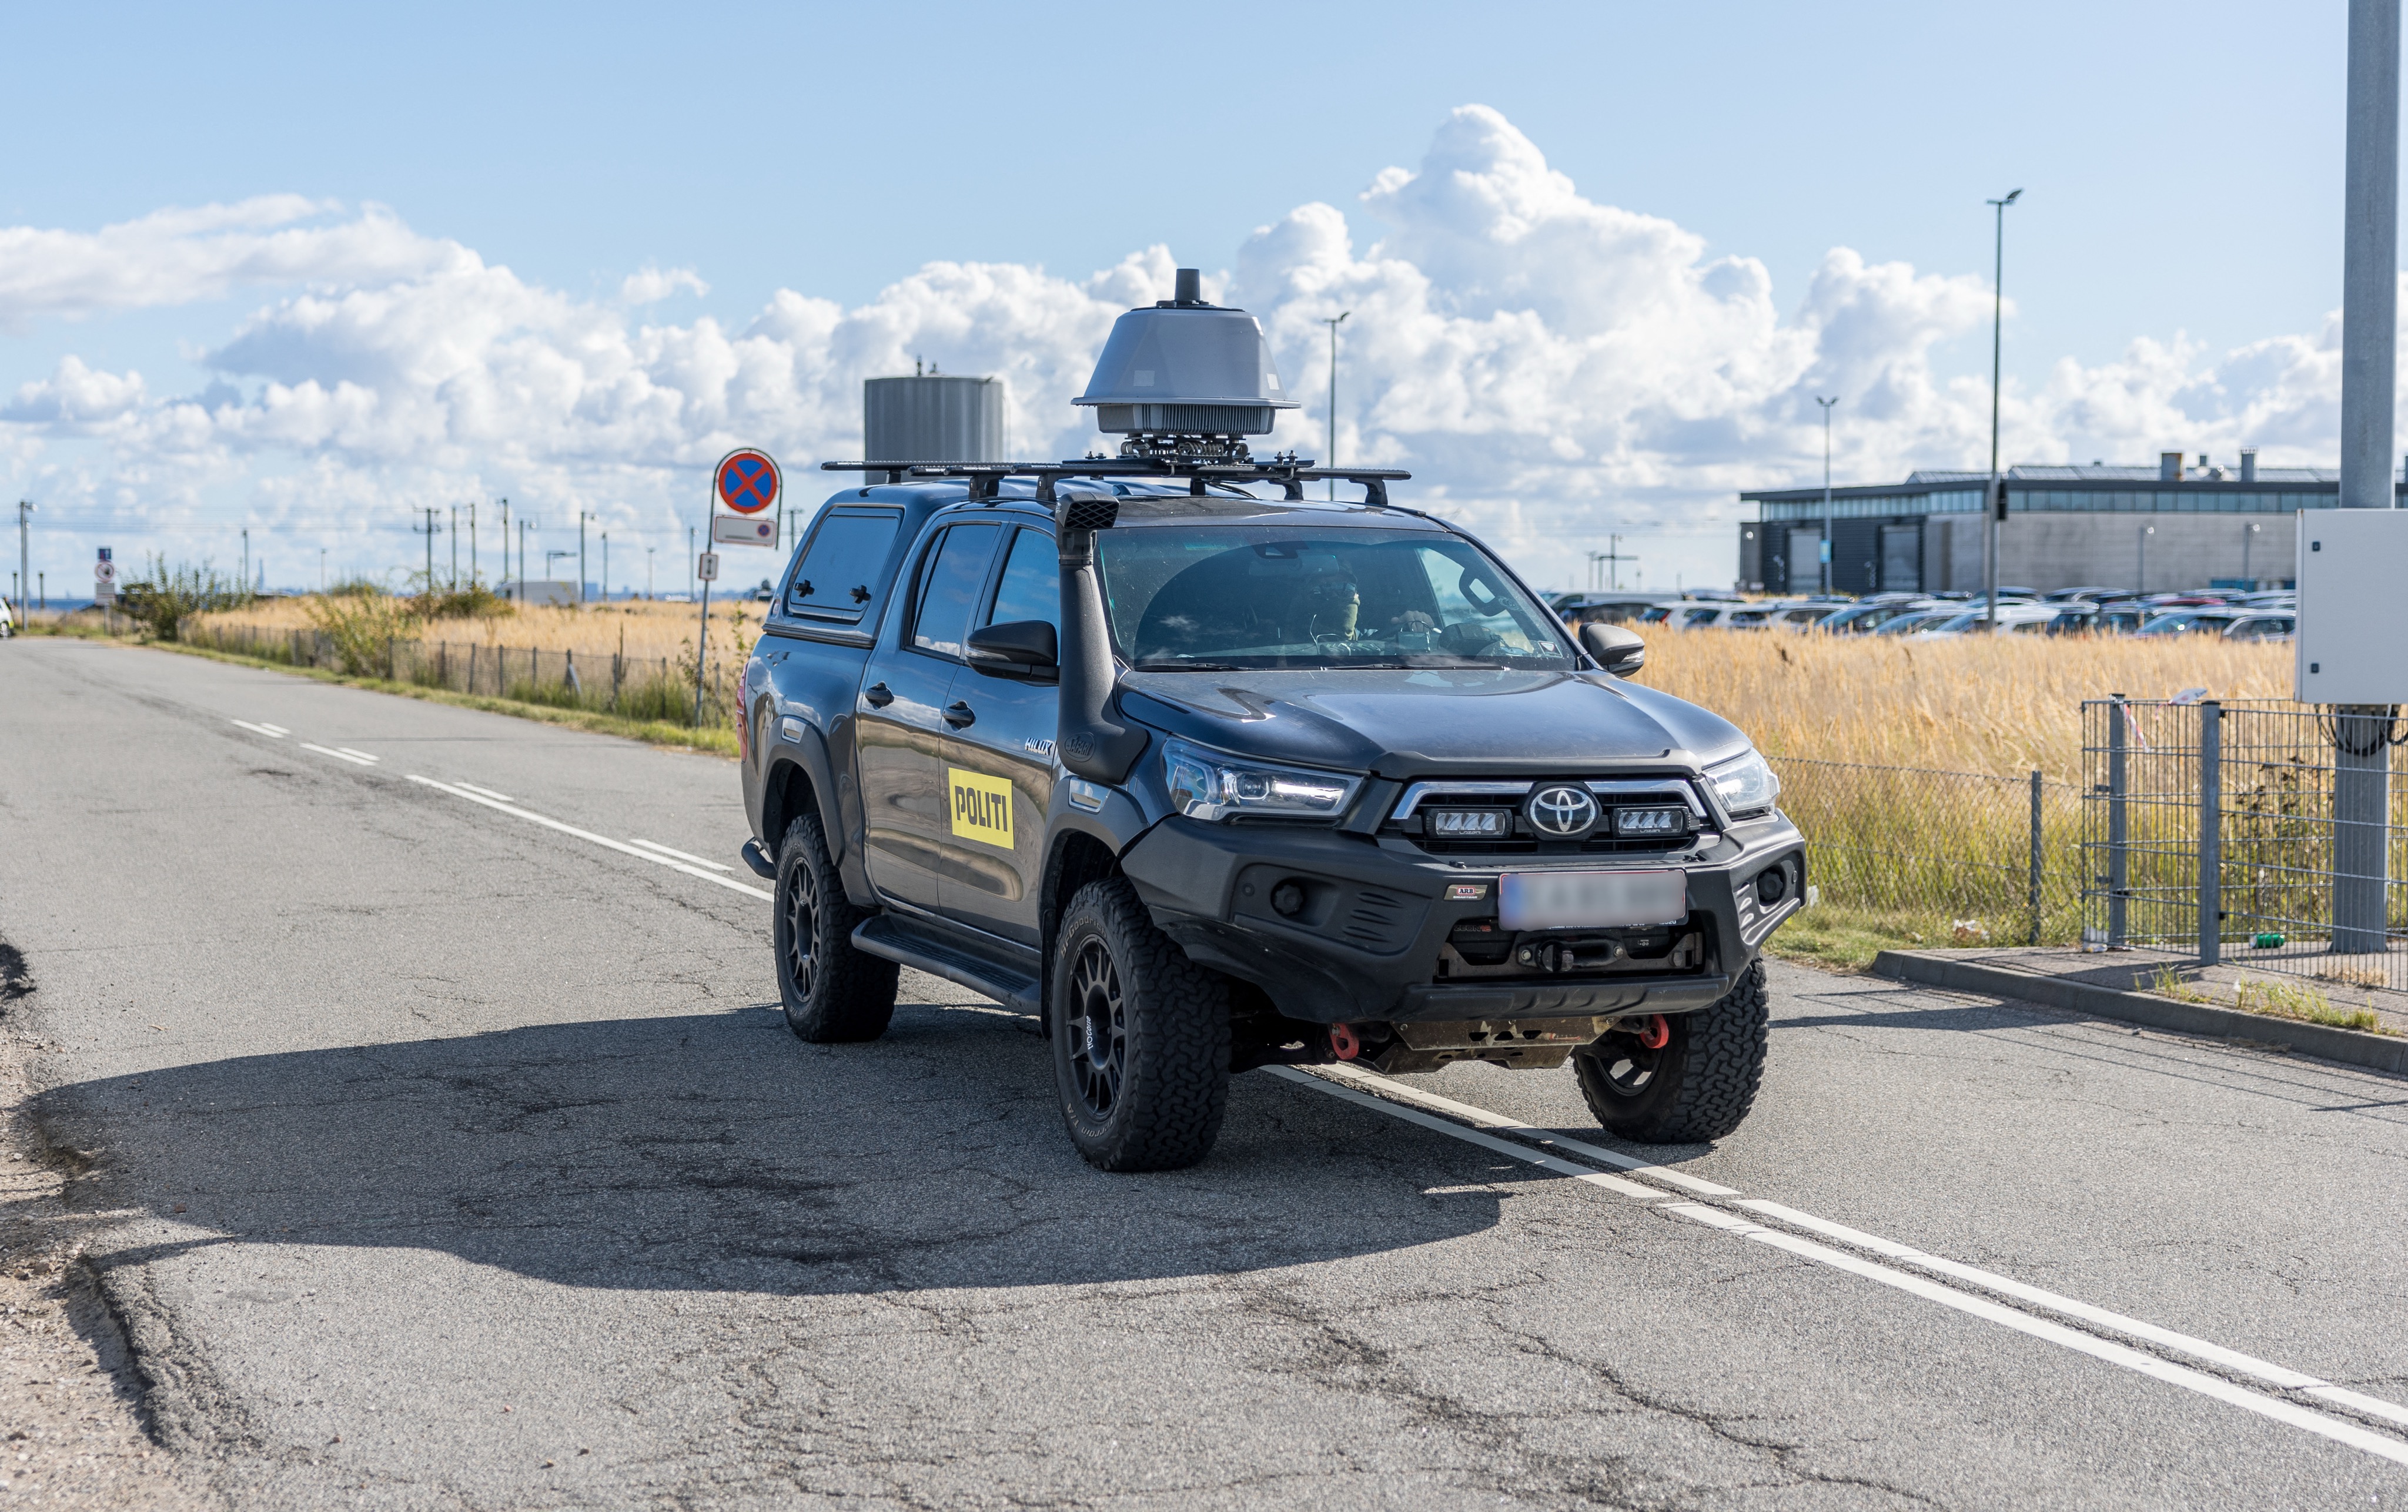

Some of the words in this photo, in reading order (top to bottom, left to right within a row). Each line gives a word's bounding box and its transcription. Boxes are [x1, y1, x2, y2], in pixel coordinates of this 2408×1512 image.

[1025, 737, 1053, 756] HILUX
[1065, 736, 1093, 756] SAFARI
[955, 785, 1008, 832] POLITI
[1061, 915, 1106, 959] BFGoodrich
